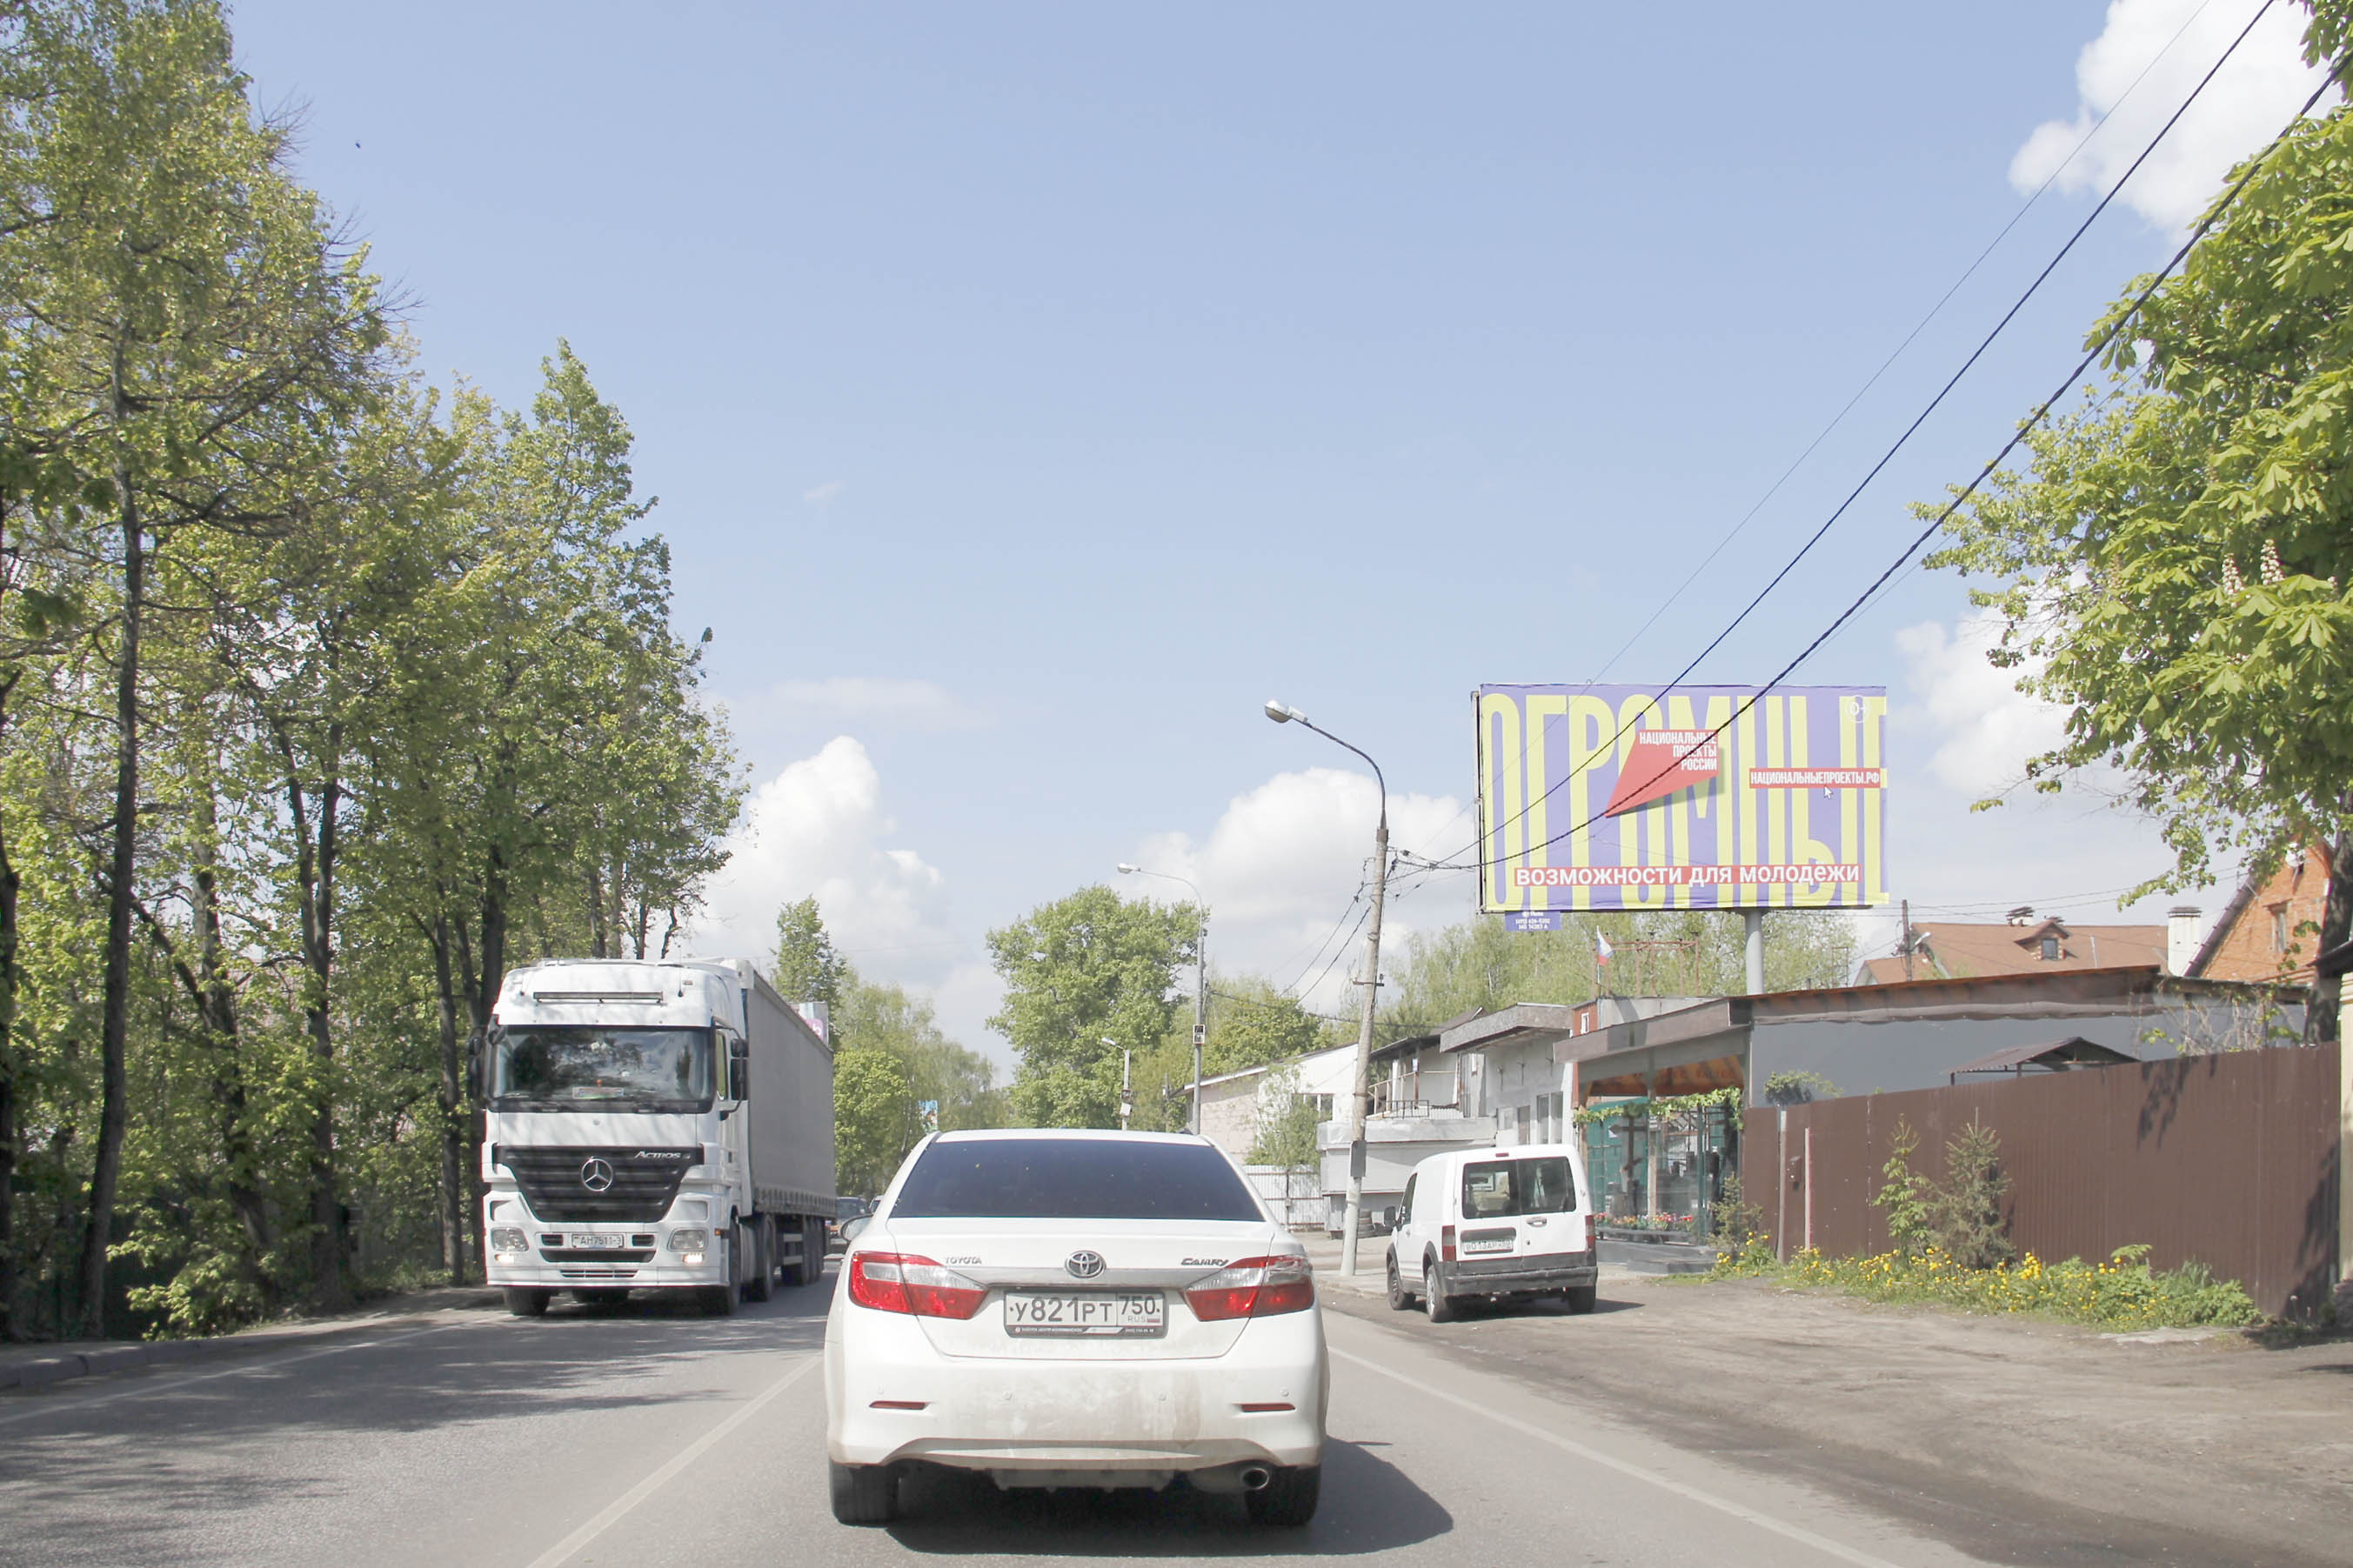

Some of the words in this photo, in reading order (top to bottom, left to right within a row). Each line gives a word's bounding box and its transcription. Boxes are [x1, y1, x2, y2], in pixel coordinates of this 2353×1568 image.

[1849, 701, 1868, 716] 0+
[1639, 731, 1717, 745] НАЦИОНАЛЬНЫЕ
[1673, 745, 1717, 757] ПРОЕКТЫ
[1681, 757, 1717, 771] РОССИИ
[1750, 771, 1880, 786] НАЦИОНАЛЬНЫЕПРОЕКТЫ.РФ
[946, 1256, 982, 1264] TOYOTA
[1118, 1296, 1156, 1315] 750
